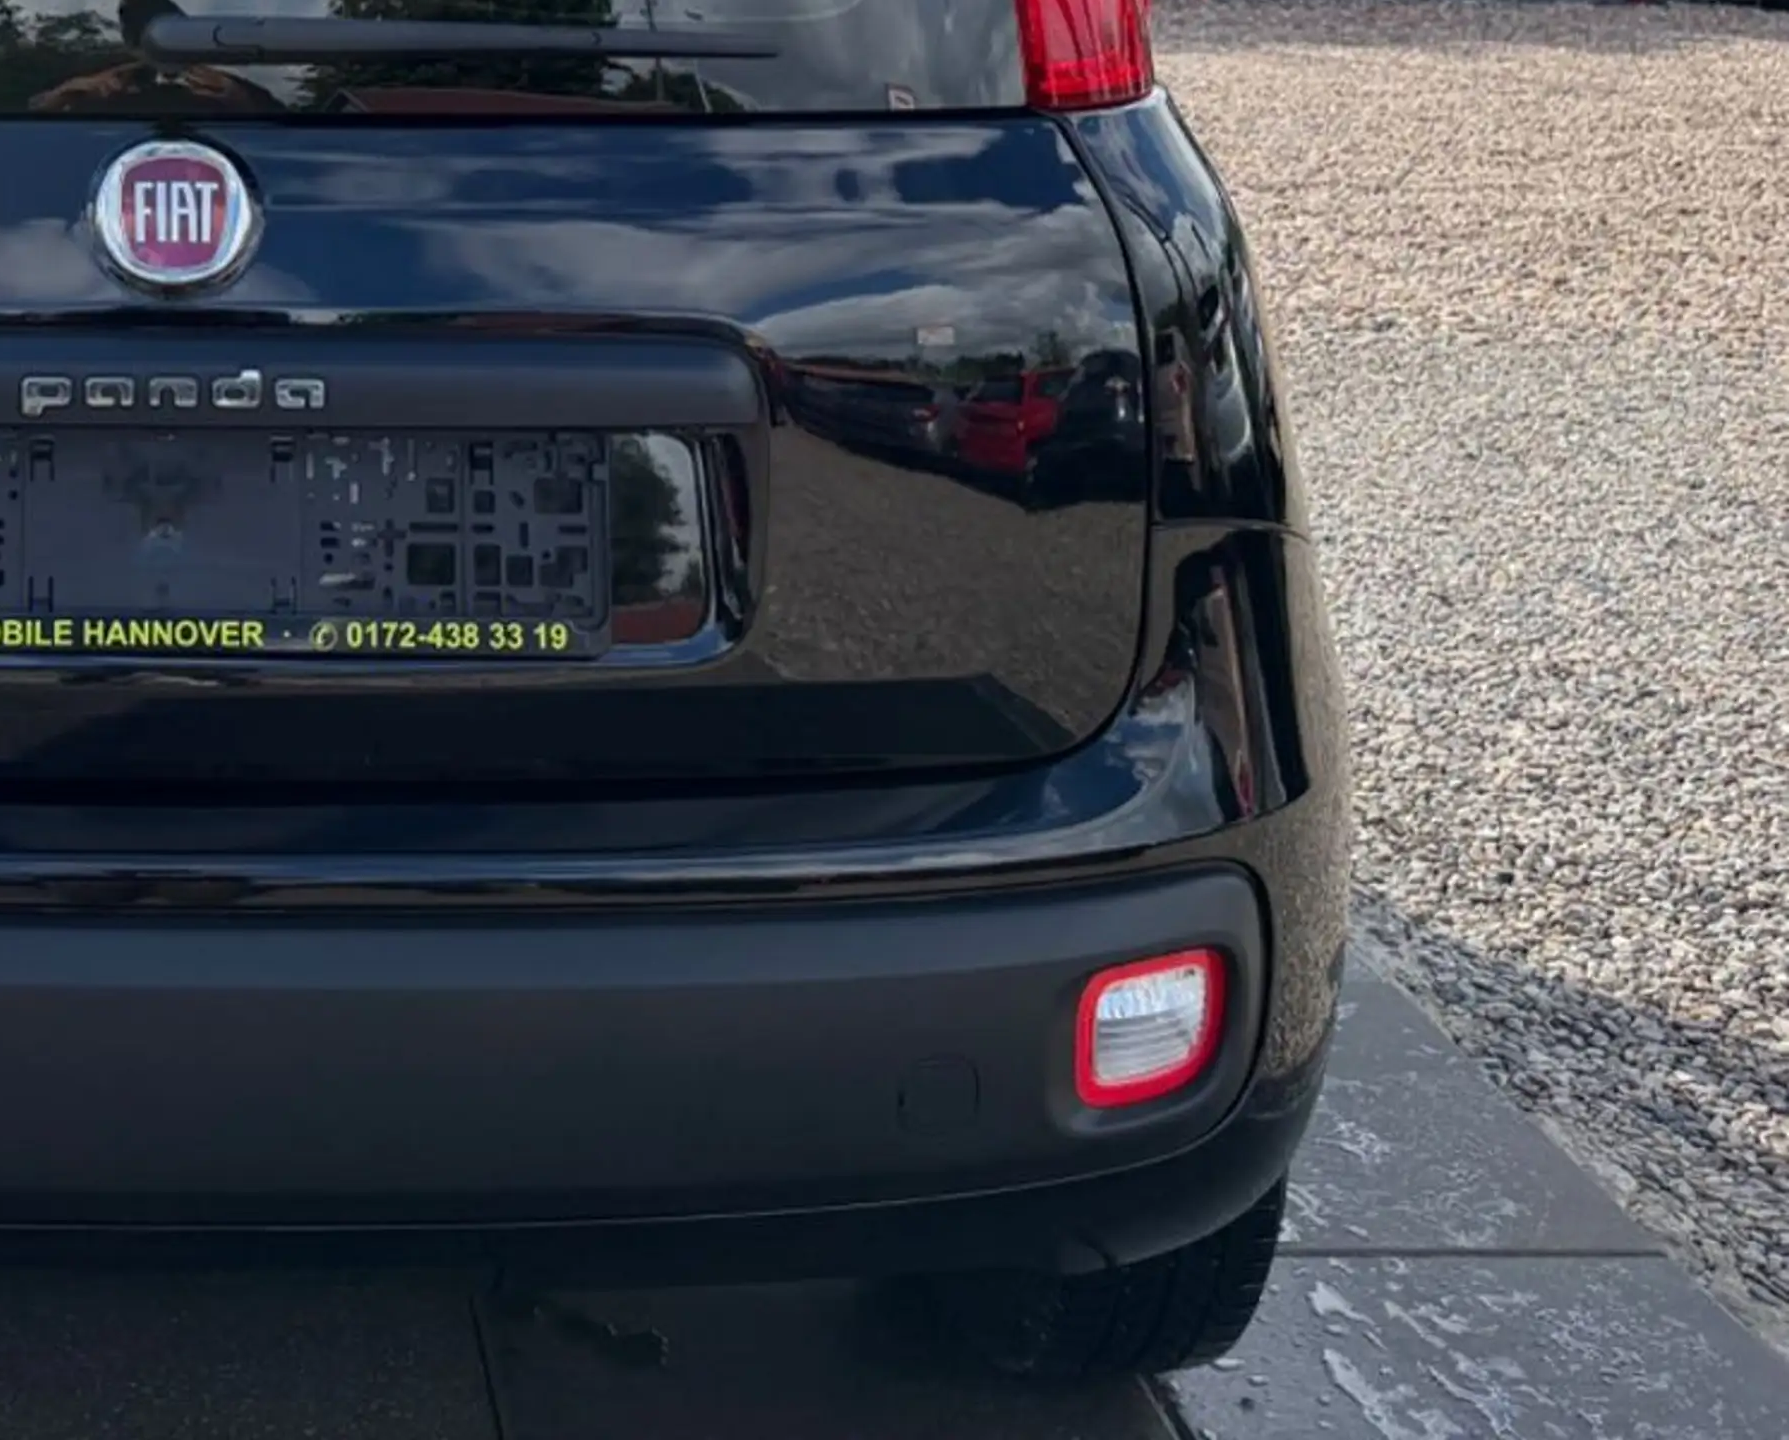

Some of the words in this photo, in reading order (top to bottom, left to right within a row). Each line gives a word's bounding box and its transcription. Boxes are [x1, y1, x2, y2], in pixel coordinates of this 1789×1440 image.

[133, 180, 219, 244] FIAT
[19, 369, 327, 417] panda
[83, 619, 264, 648] HANNOVER
[346, 621, 480, 650] 0172-438
[489, 622, 524, 650] 33
[534, 622, 569, 650] 19
